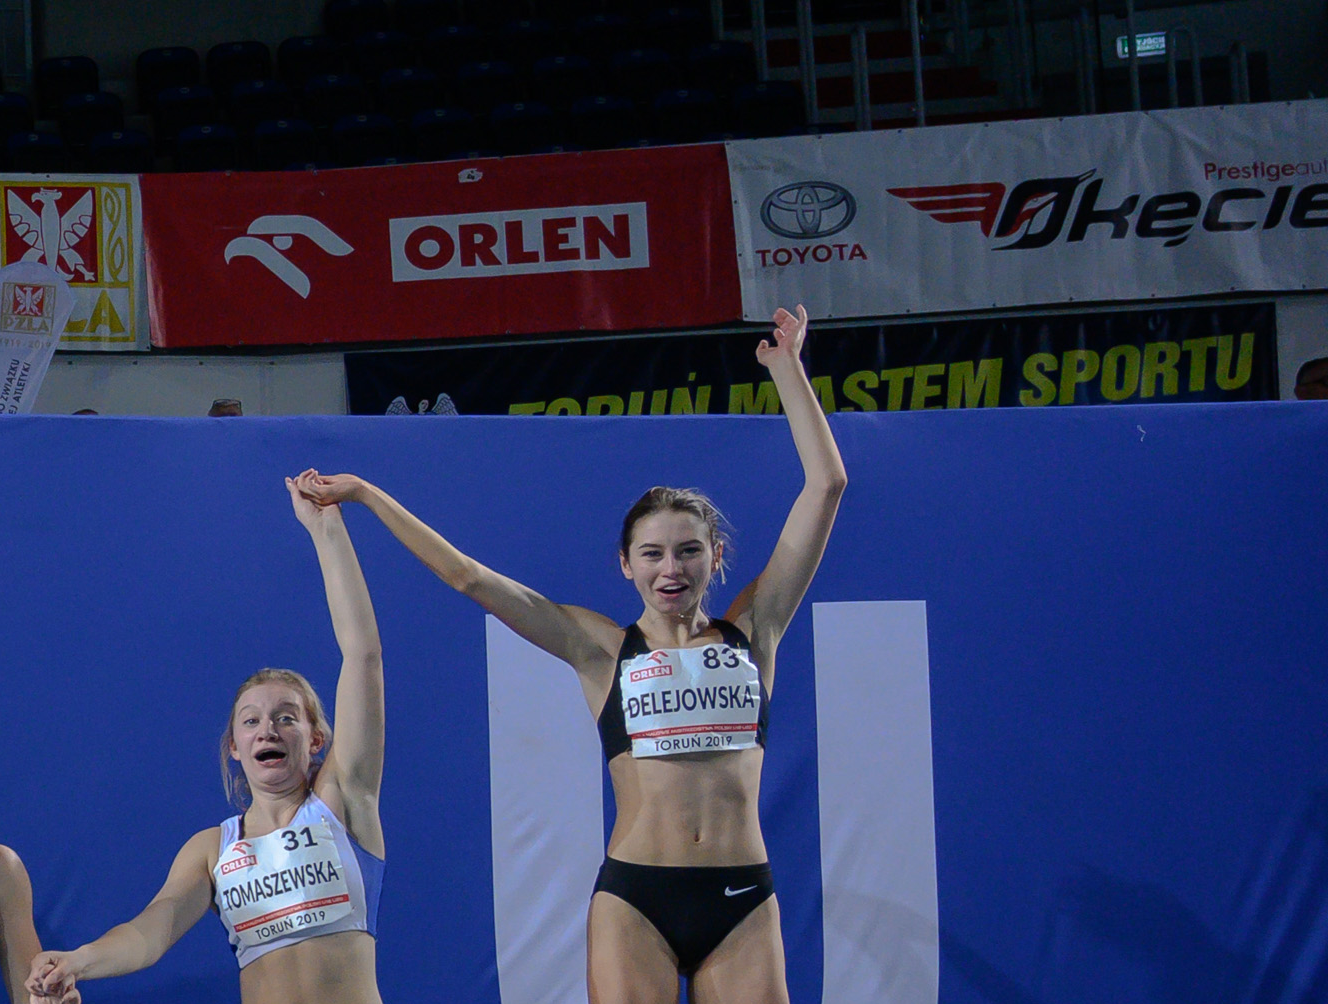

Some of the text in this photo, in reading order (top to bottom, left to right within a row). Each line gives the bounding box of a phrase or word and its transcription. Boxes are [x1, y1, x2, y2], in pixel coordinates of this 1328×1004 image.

[404, 213, 632, 271] ORLEN
[756, 242, 868, 268] TOYOTA
[729, 357, 1003, 414] MASTEM
[1020, 333, 1254, 408] SPORTU
[631, 648, 740, 681] ORLEN 83
[628, 685, 755, 719] DELEJOWSKA
[655, 734, 701, 751] TORUŃ
[223, 827, 318, 872] ORLEN 31
[223, 860, 339, 911] TOMASZEWSKA
[255, 916, 293, 940] TORUŃ
[296, 910, 326, 926] 2019
